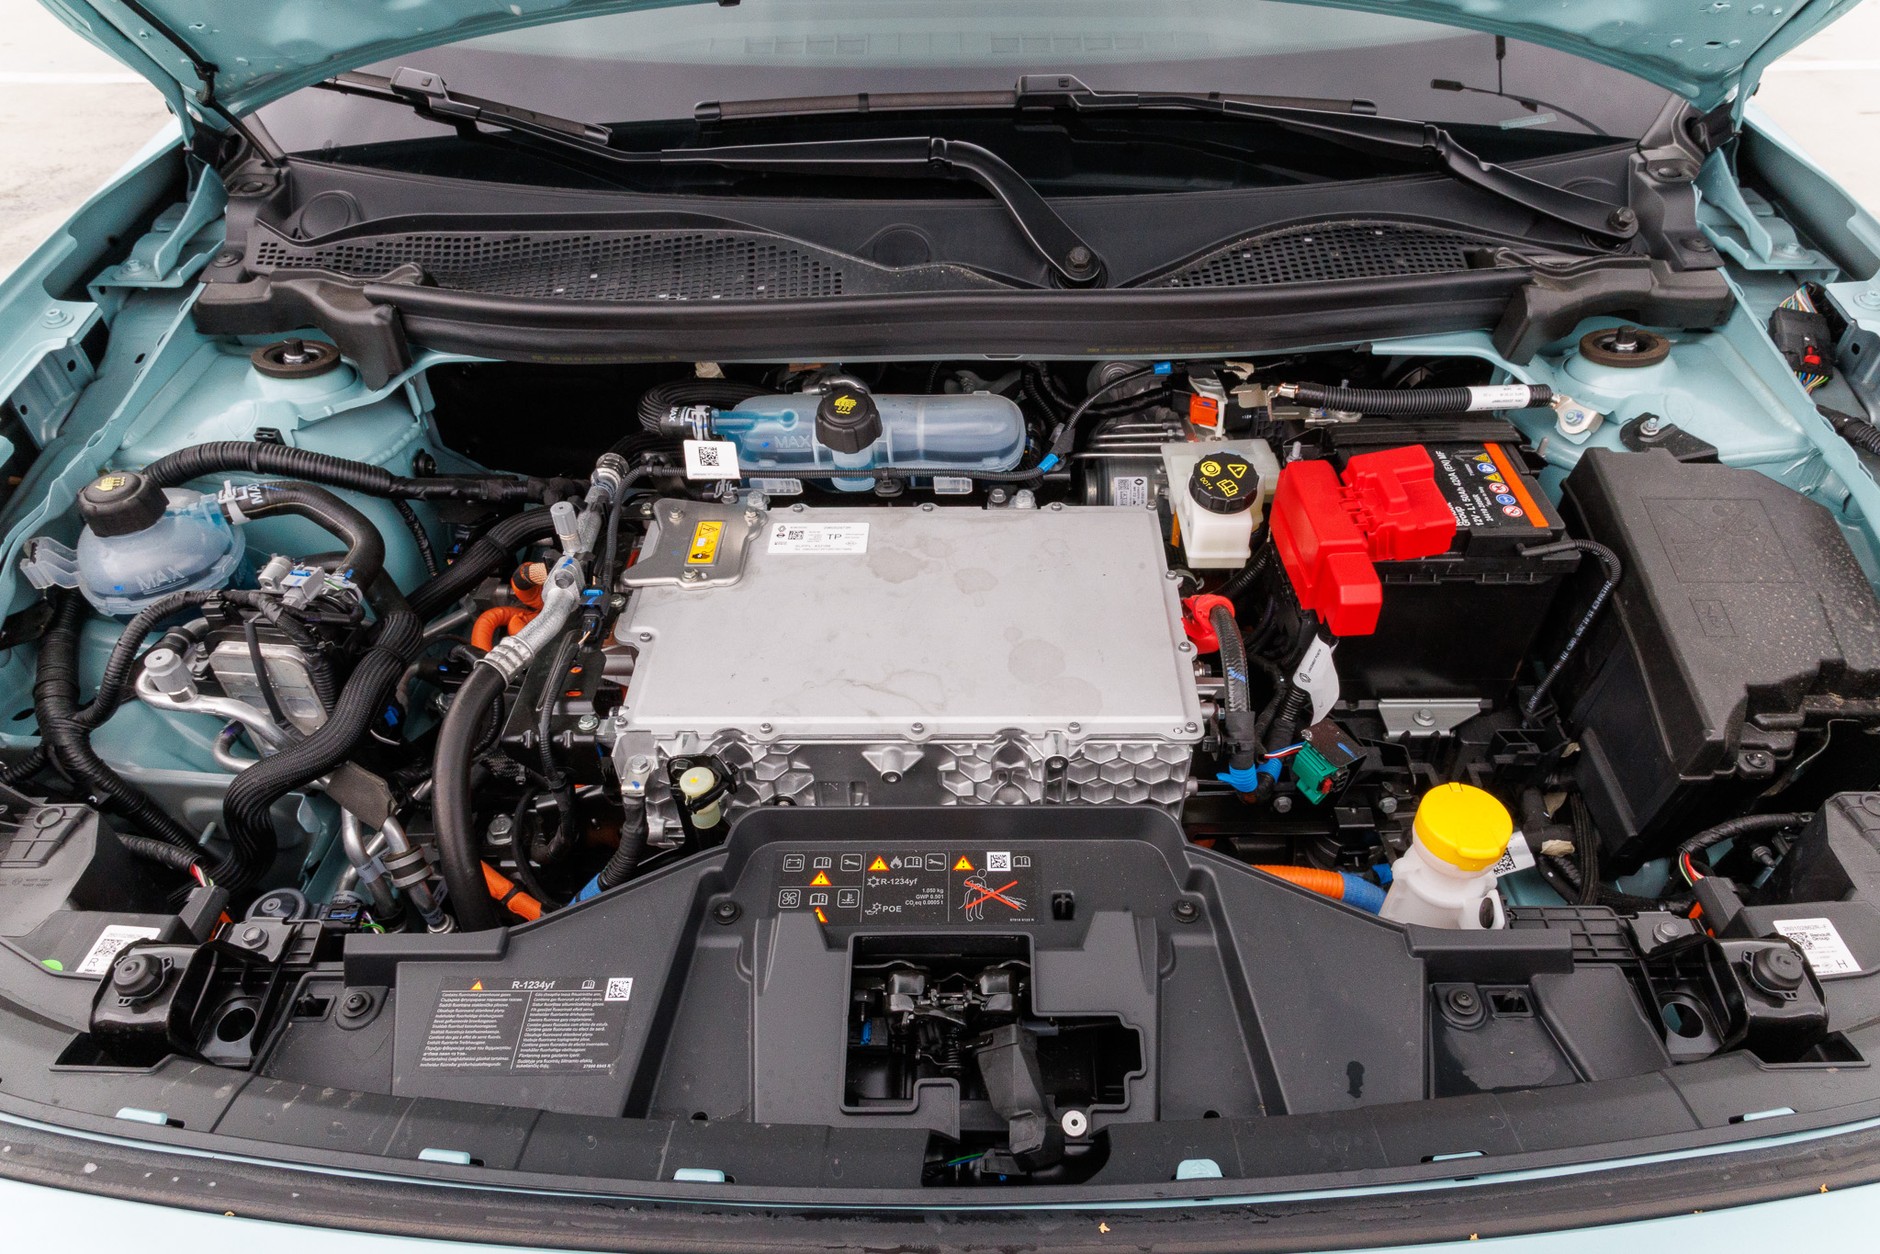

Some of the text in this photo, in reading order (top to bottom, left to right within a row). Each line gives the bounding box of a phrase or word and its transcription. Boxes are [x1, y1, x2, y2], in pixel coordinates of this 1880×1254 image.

[774, 434, 812, 448] MAX
[1441, 459, 1455, 472] (EN)
[1200, 477, 1211, 487] DOT
[1448, 472, 1461, 487] 420A
[1457, 486, 1470, 502] 50Ah
[1465, 502, 1475, 511] L1
[1455, 506, 1471, 527] Group
[1471, 513, 1484, 526] 12V
[135, 566, 185, 590] MAX
[880, 878, 918, 886] R-1234yf
[88, 958, 99, 966] R
[1836, 960, 1848, 968] H
[512, 980, 556, 990] R-1234yf
